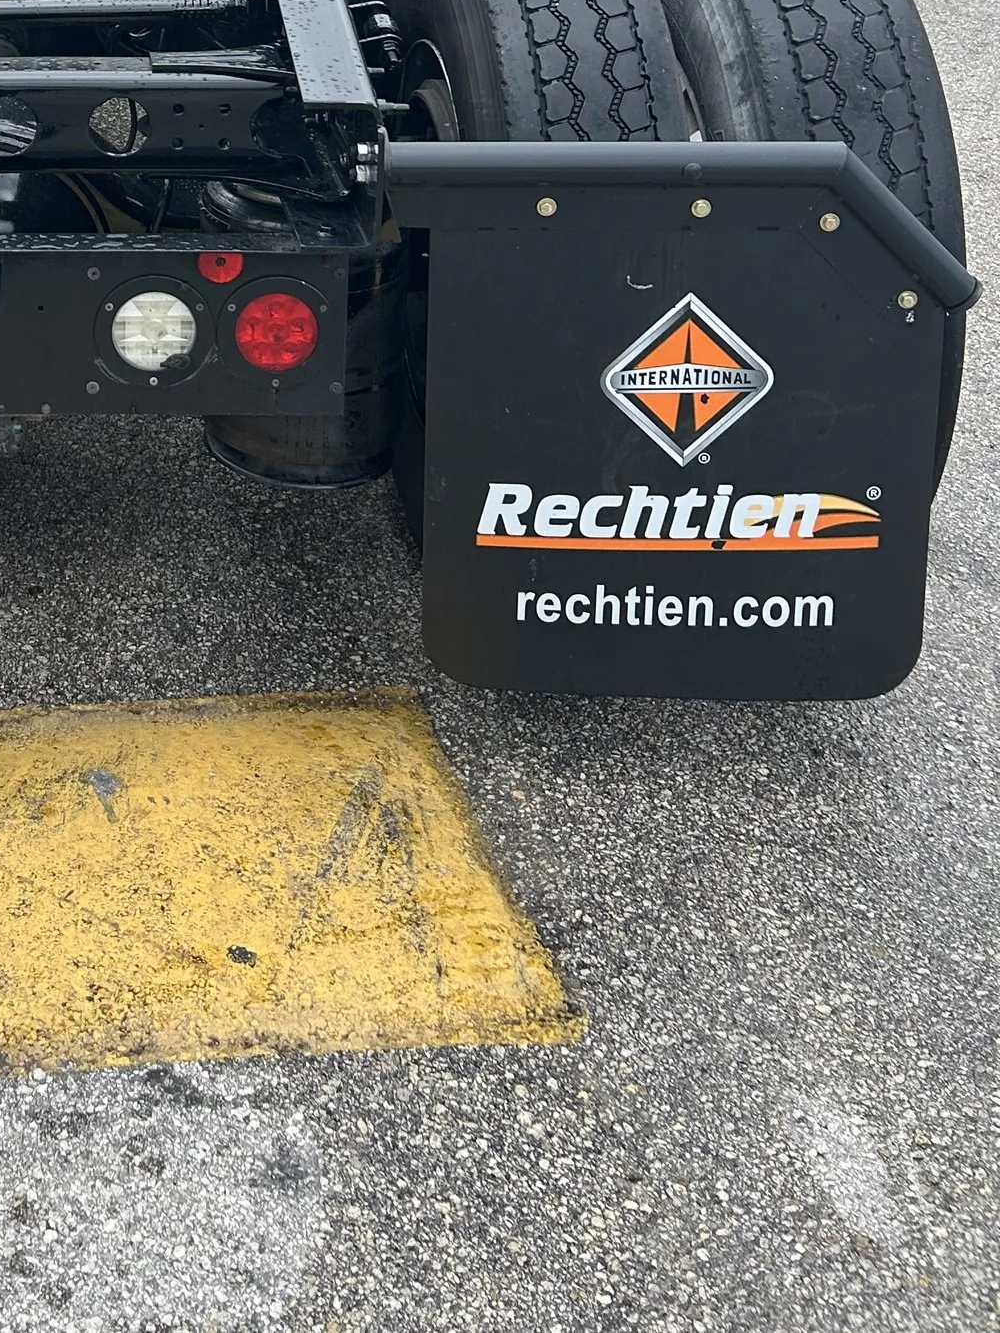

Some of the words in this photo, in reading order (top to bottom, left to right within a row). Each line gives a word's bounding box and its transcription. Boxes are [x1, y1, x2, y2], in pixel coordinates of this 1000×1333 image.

[620, 368, 752, 386] INTERNATIONAL
[476, 483, 821, 540] Rechtien
[516, 584, 834, 627] rechtien.com
